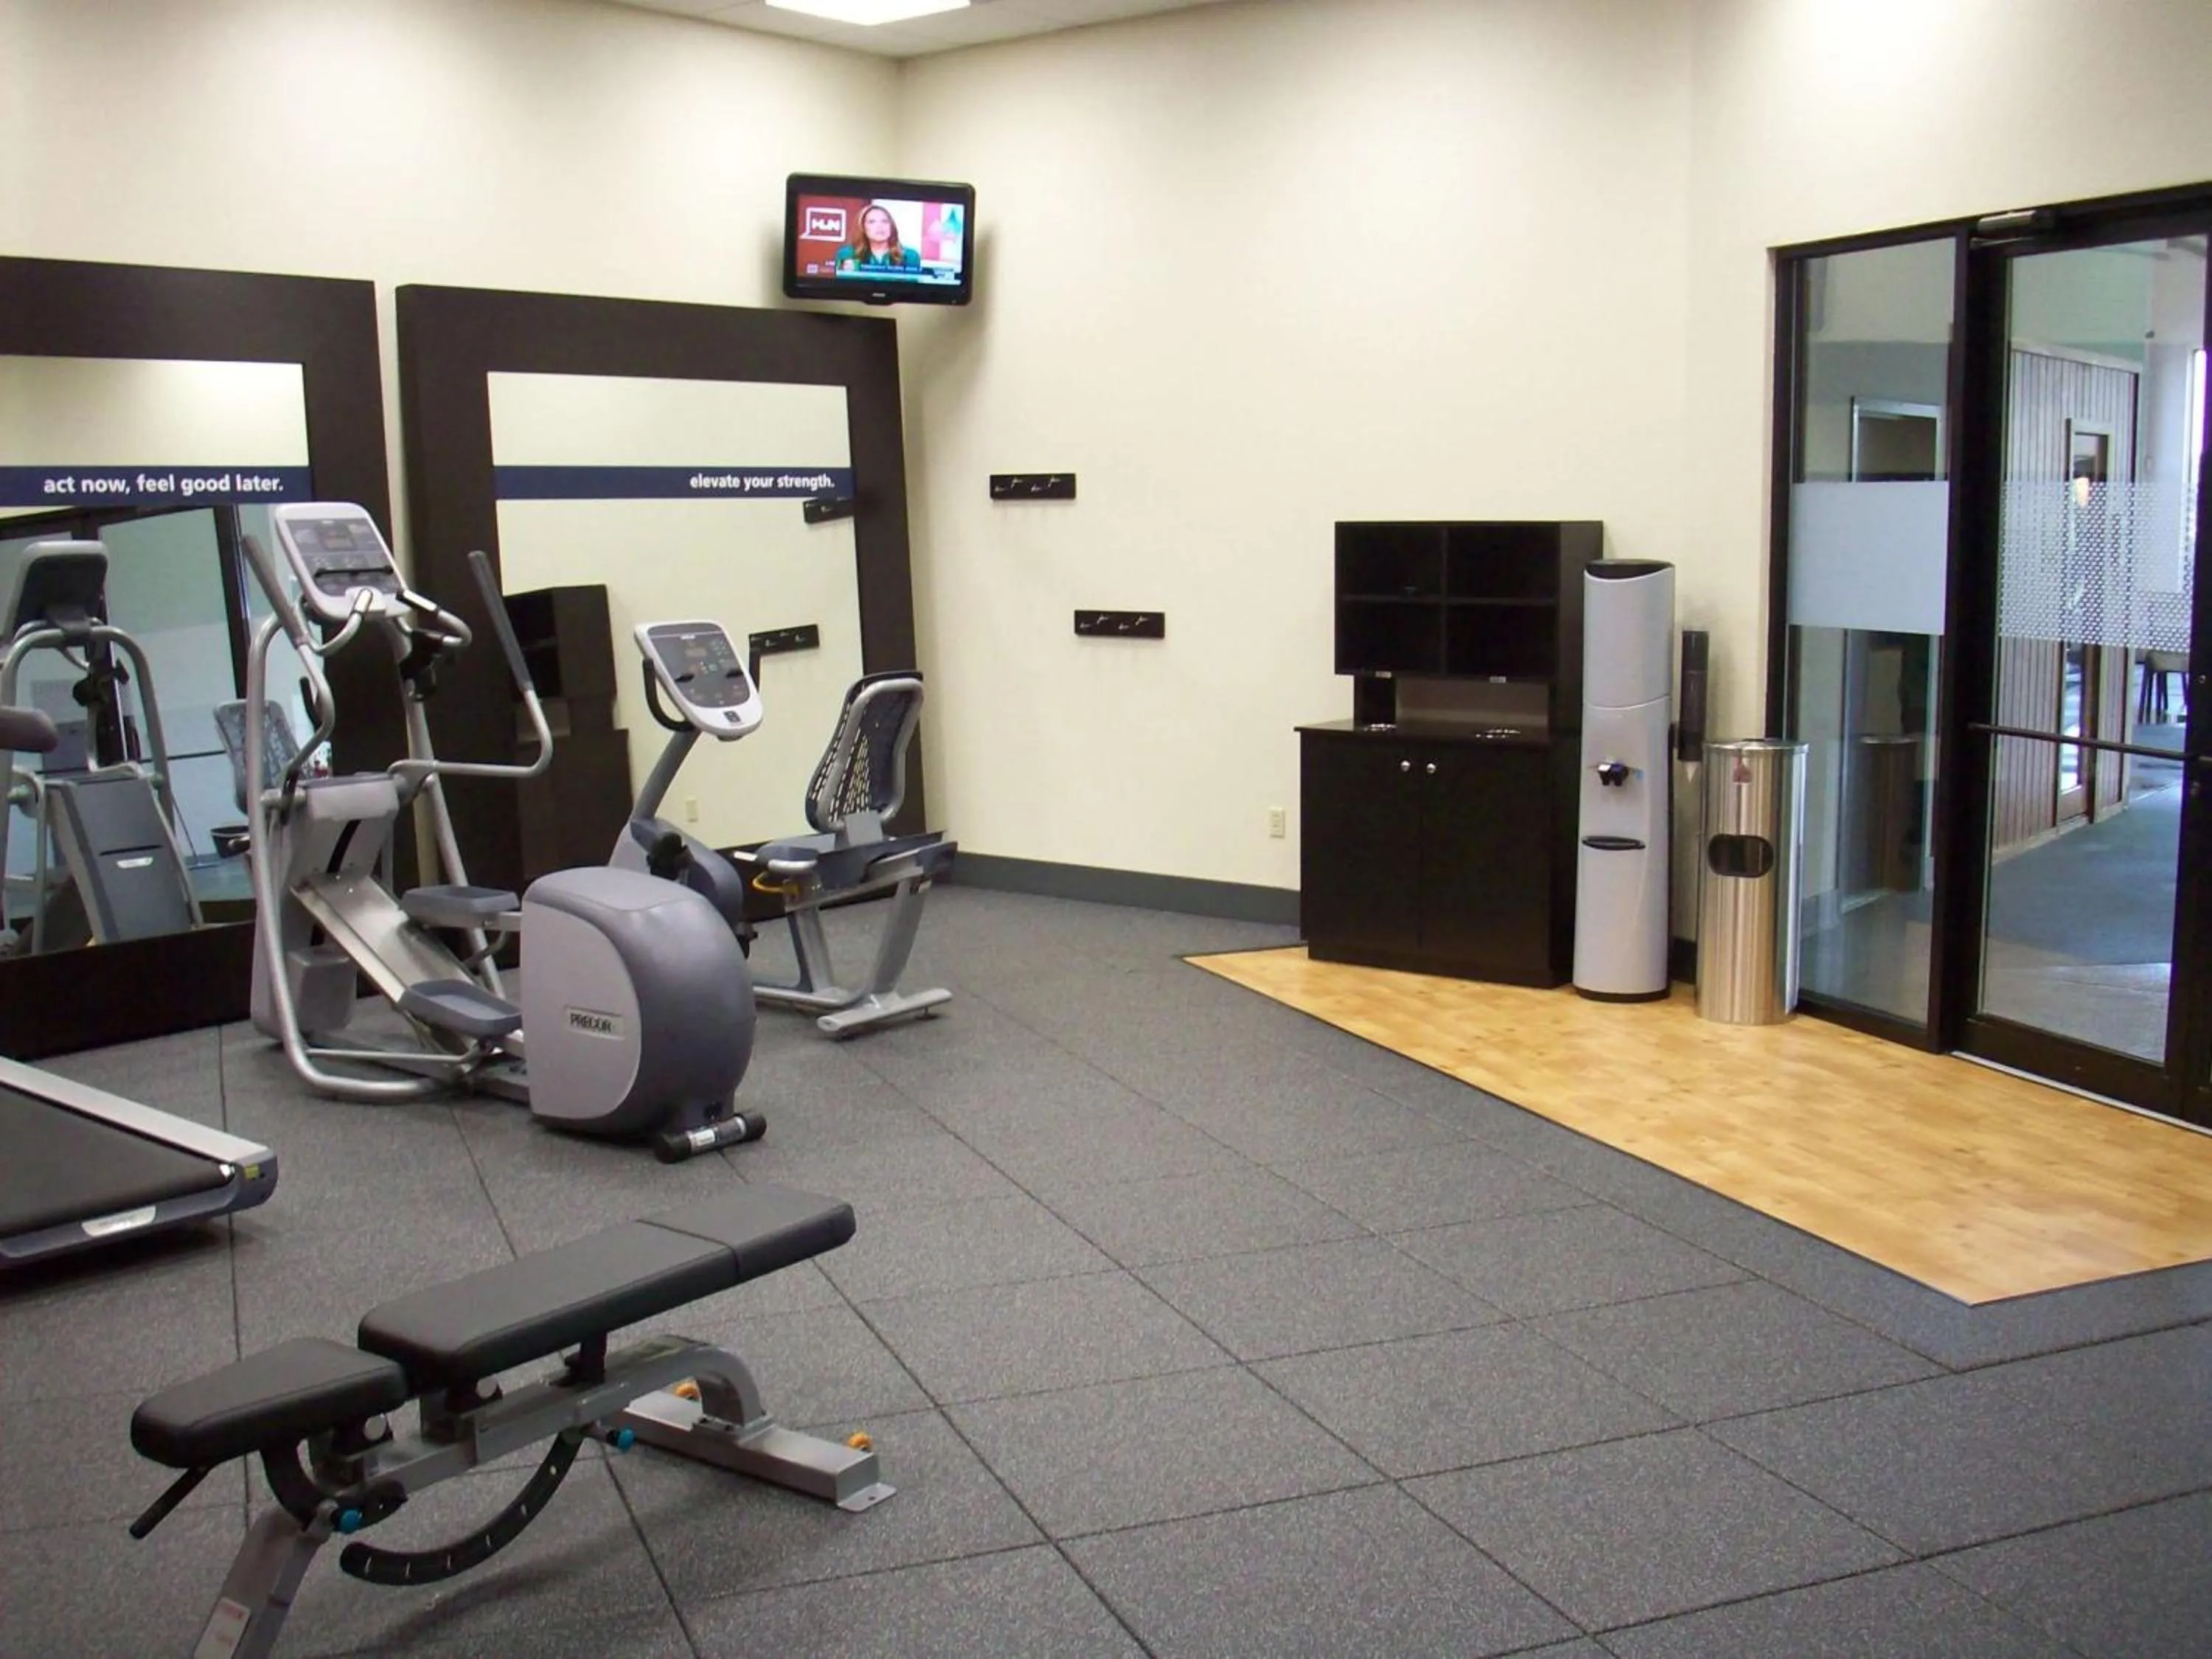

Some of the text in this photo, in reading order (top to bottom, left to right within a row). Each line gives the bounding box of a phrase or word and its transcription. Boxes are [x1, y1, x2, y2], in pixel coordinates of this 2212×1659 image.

[44, 473, 284, 496] act now, feel good later.
[689, 473, 835, 492] elevate your strength.
[570, 1012, 612, 1033] PRECOR
